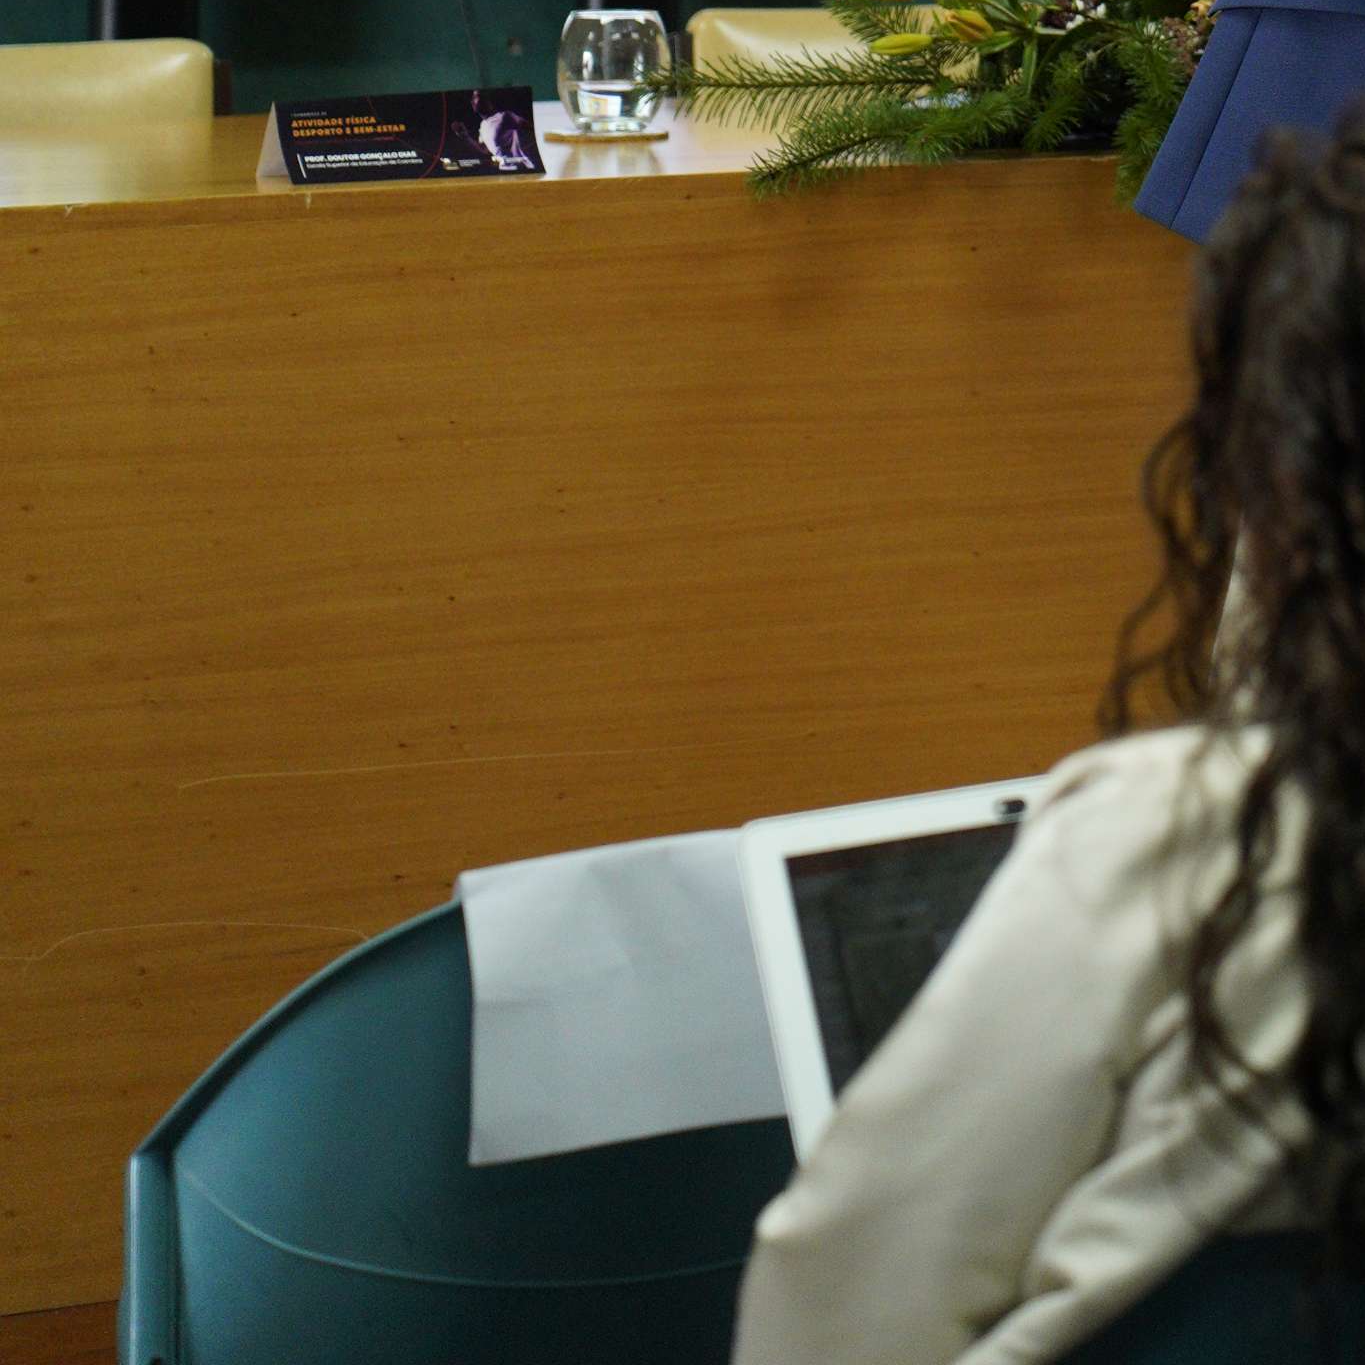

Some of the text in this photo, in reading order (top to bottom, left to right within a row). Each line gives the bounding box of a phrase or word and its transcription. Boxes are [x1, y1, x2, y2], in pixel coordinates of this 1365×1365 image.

[291, 115, 376, 127] ATIVIDADE FÍSICA
[293, 127, 343, 137] DESPORTO
